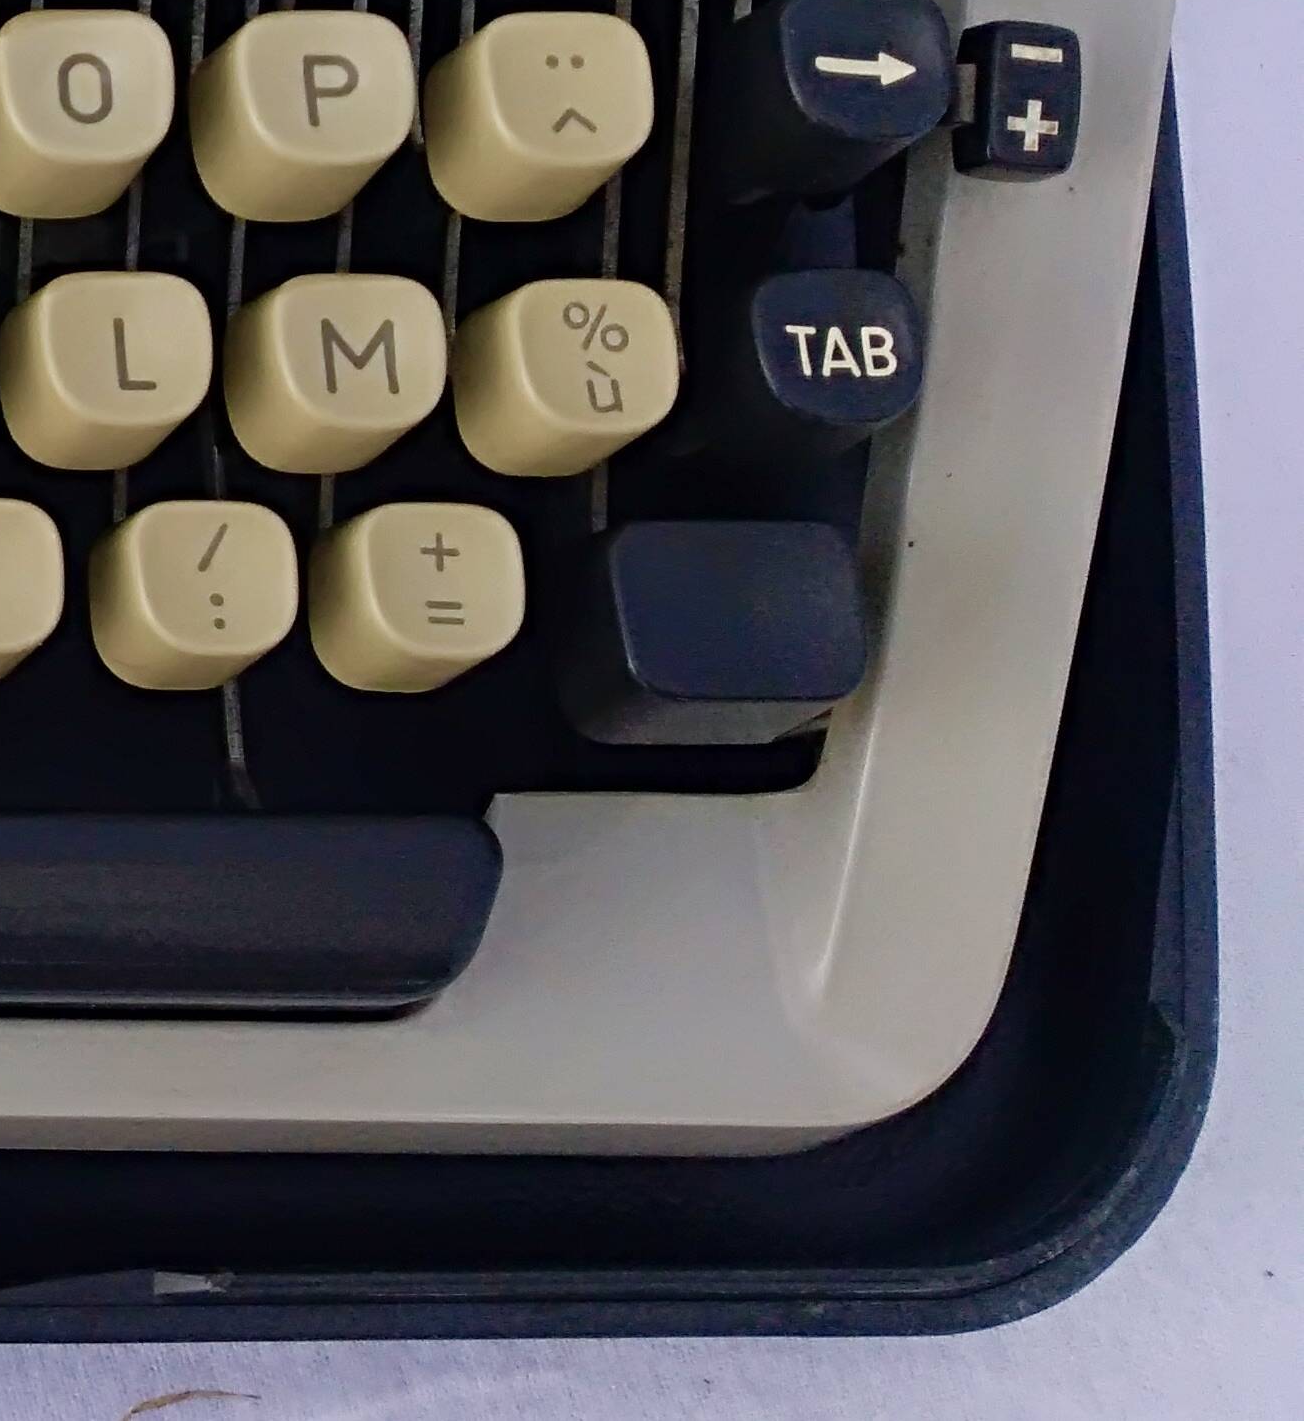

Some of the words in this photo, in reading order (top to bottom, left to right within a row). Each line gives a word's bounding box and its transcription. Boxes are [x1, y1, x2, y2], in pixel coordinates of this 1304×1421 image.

[57, 52, 114, 125] O
[302, 54, 360, 128] P
[112, 317, 158, 392] L
[562, 300, 631, 355] %
[785, 322, 899, 379] TAB
[320, 317, 400, 395] M
[585, 360, 624, 414] ù
[197, 522, 229, 573] /
[209, 592, 226, 630] :
[424, 600, 466, 626] =
